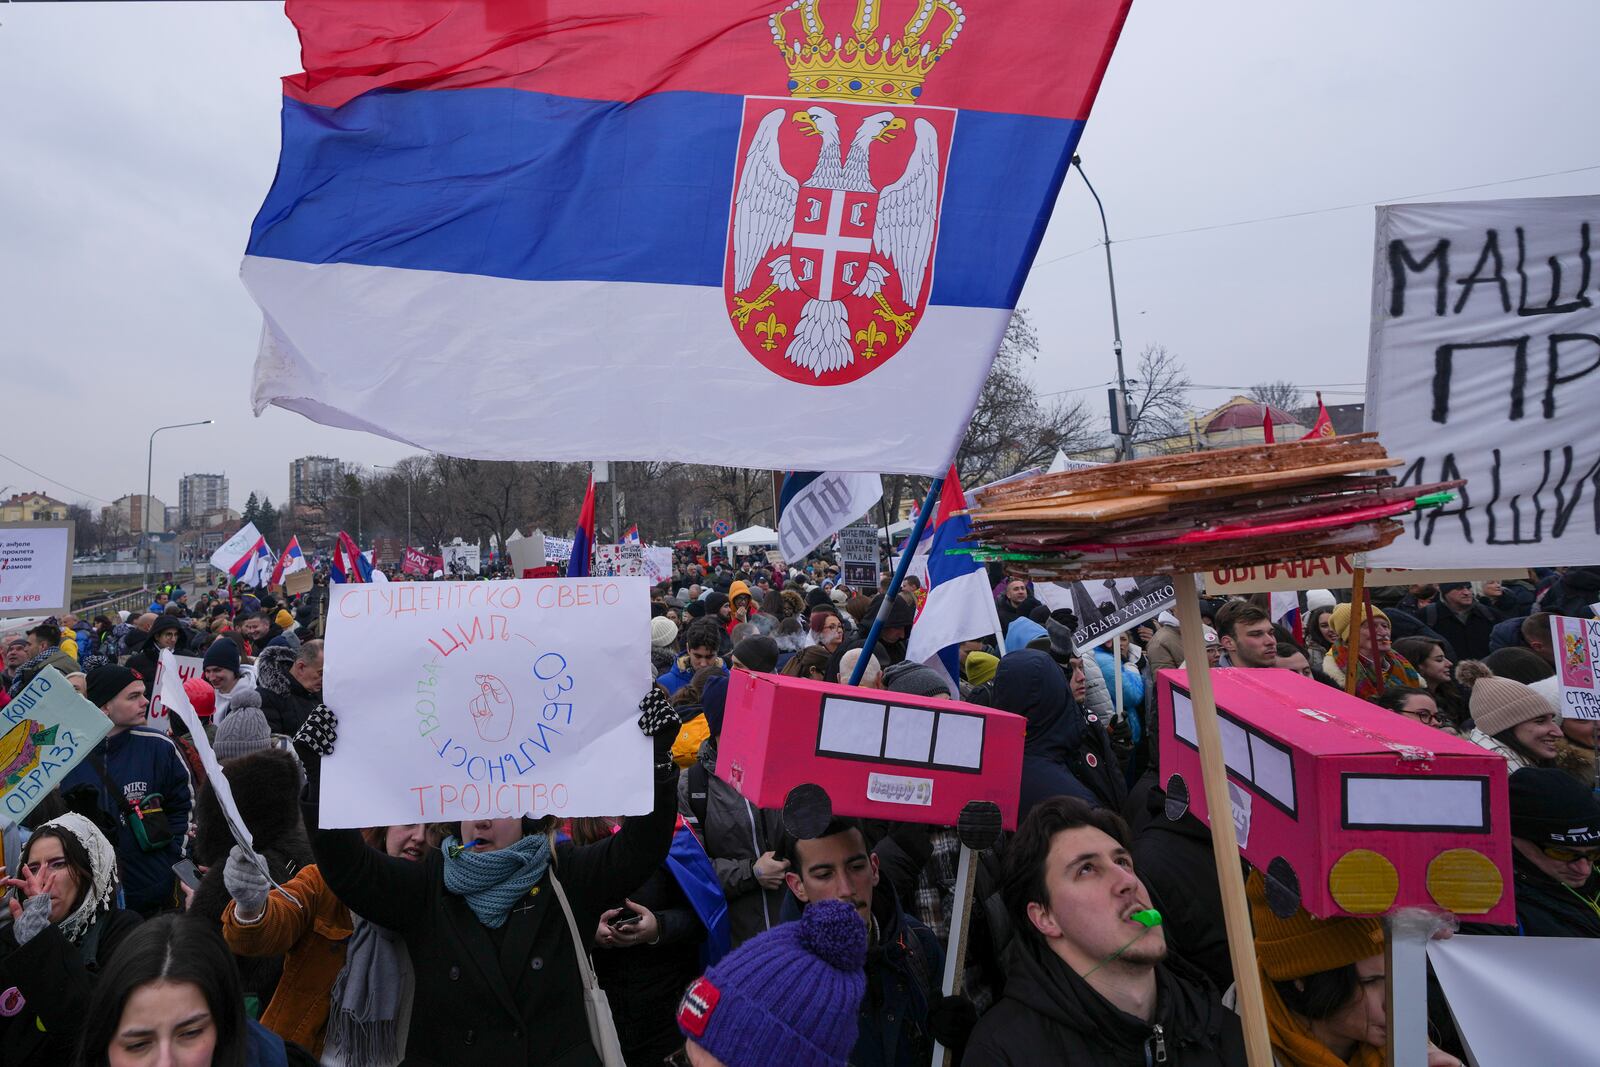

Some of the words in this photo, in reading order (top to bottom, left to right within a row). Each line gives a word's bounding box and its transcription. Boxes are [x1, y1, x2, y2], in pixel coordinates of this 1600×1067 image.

[1388, 222, 1600, 317] МАШ
[24, 594, 41, 602] КРВ
[340, 585, 521, 619] СТУДЕНТСКО
[536, 583, 620, 609] СВЕТО
[1073, 612, 1121, 645] БУБАЊ
[1575, 705, 1600, 719] ПЛА
[6, 731, 80, 814] ОБРАЗ?
[123, 781, 148, 795] NIKE
[870, 775, 916, 802] happy
[410, 783, 569, 816] ТРОЈСТВО
